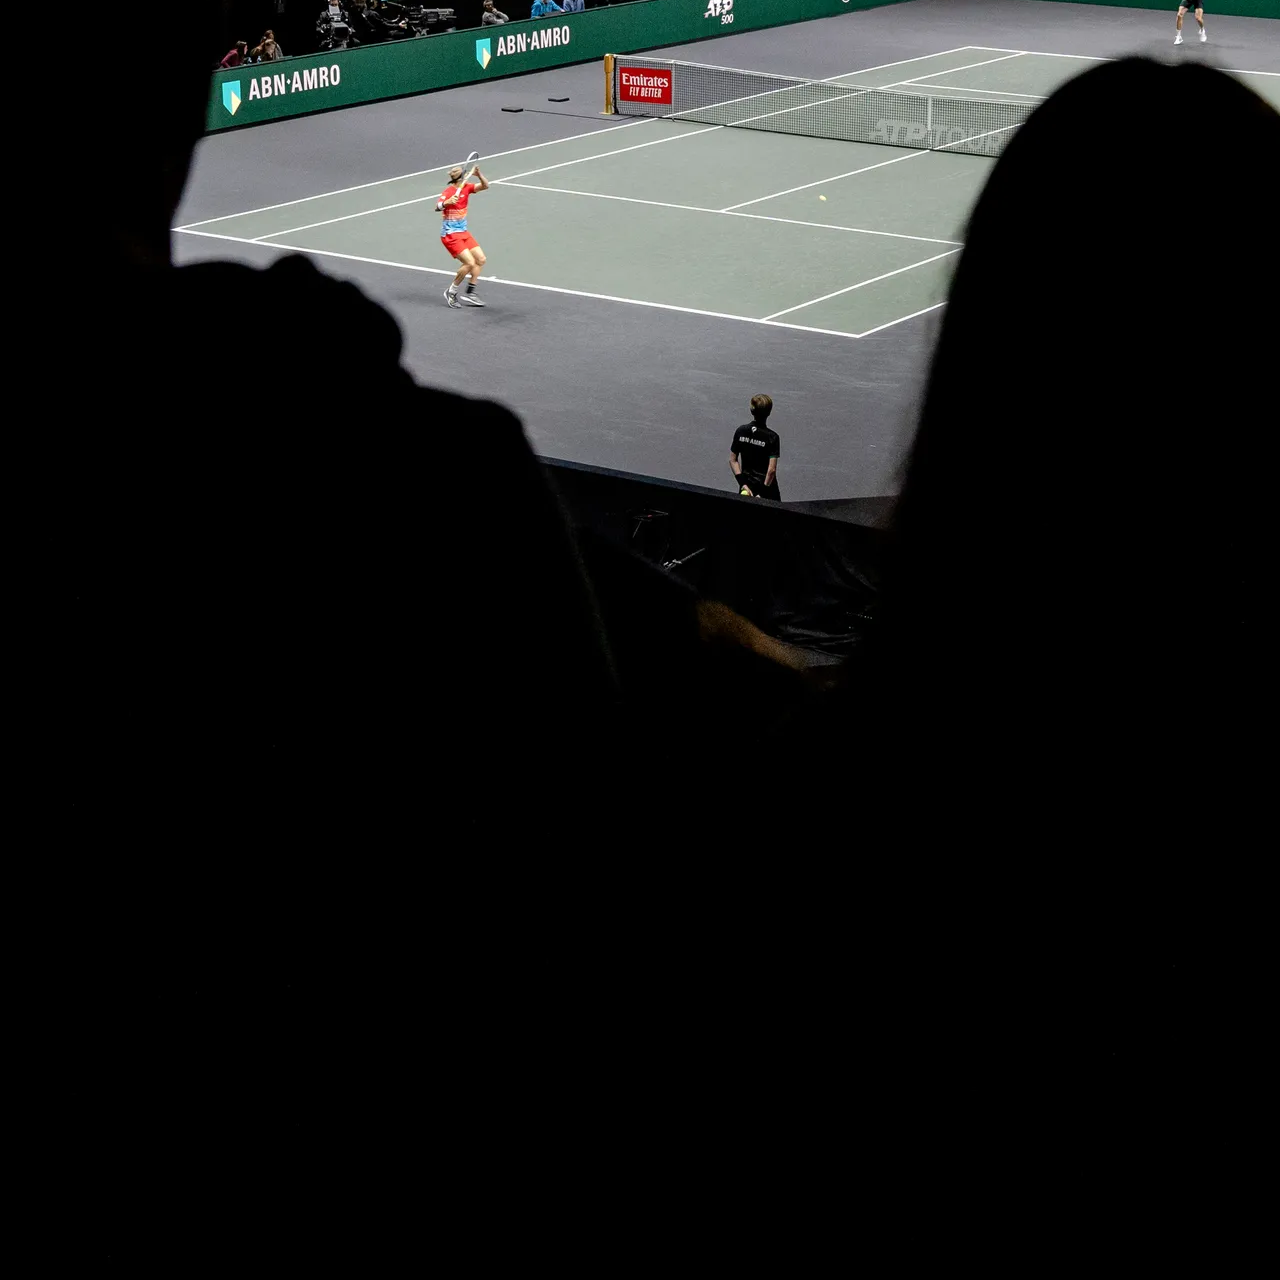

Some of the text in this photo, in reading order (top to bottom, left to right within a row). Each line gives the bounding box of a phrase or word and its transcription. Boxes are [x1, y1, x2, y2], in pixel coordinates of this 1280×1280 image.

[721, 14, 734, 25] 500
[622, 72, 669, 88] Emirates
[629, 86, 662, 98] FLY BETTER
